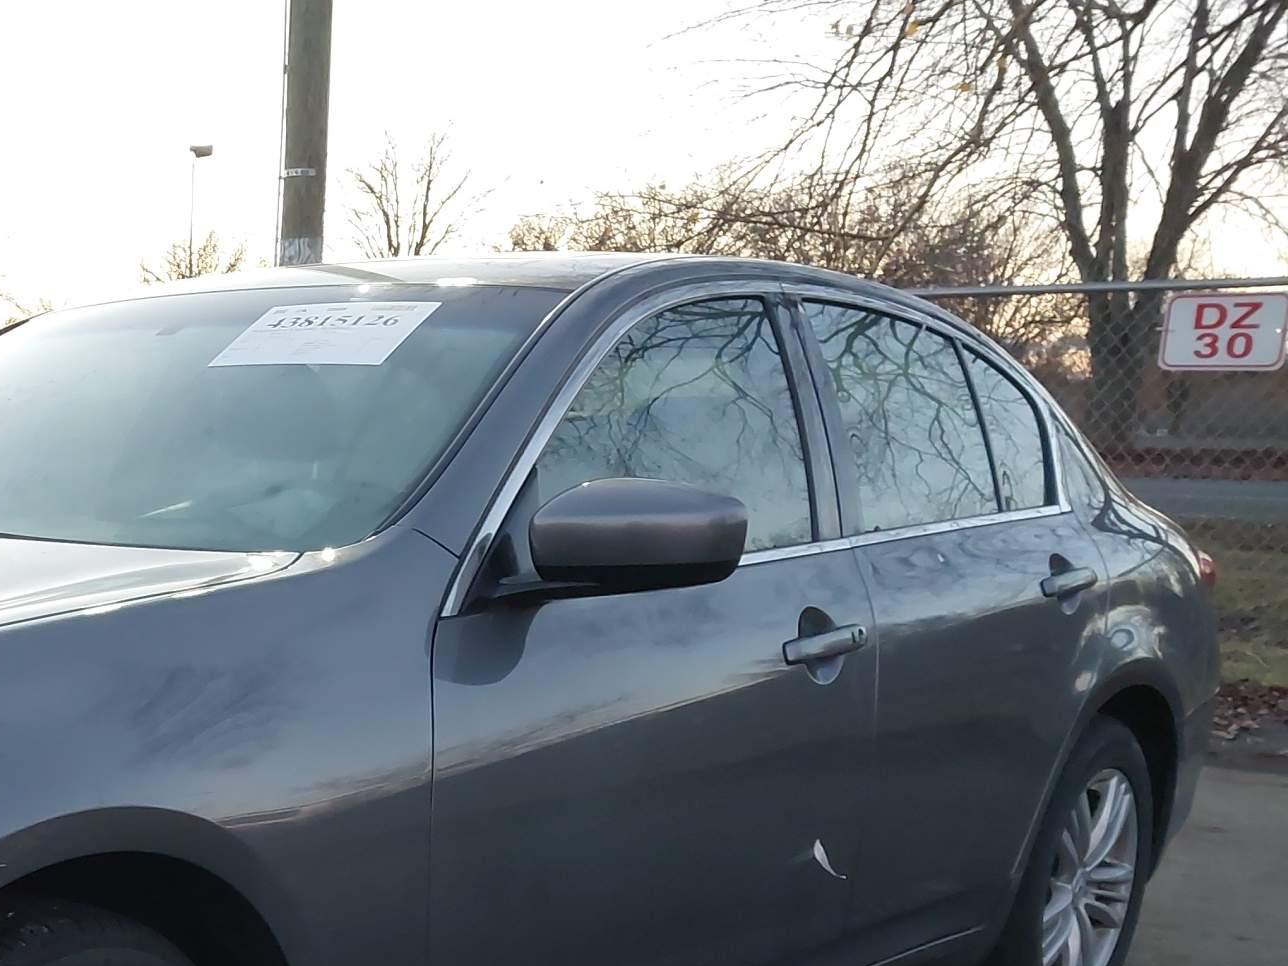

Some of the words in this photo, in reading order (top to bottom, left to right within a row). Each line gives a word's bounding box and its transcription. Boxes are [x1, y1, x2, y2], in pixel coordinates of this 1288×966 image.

[265, 313, 399, 329] 43815126
[1193, 302, 1265, 330] DZ
[1192, 331, 1255, 360] 30
